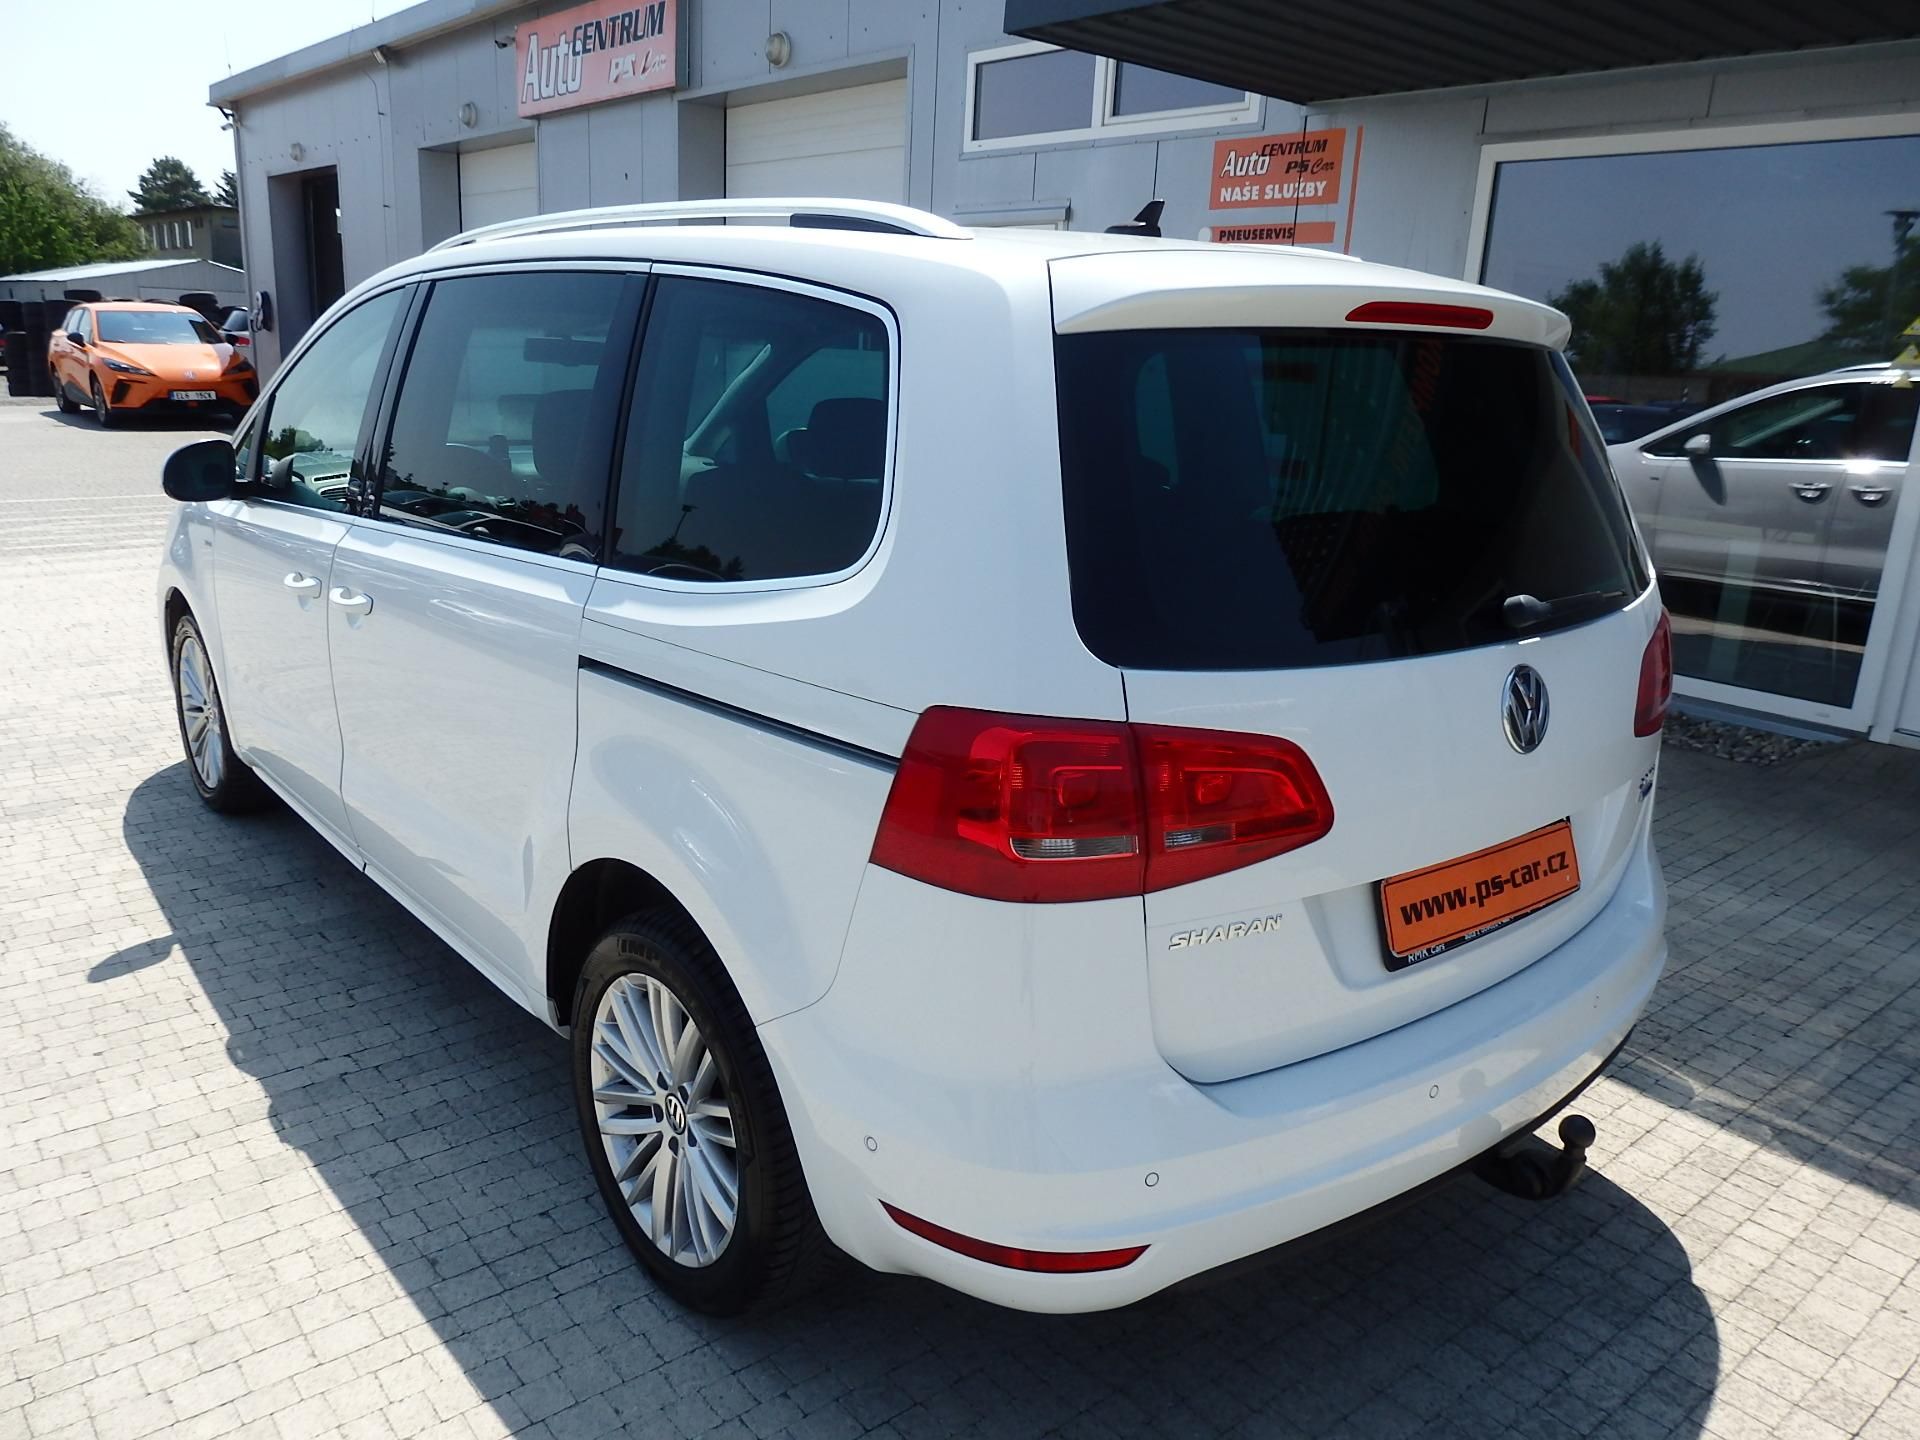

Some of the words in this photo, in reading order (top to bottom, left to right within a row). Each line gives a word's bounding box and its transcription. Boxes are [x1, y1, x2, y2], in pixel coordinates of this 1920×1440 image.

[521, 32, 583, 104] Auto
[571, 1, 666, 56] CENTRUM
[1220, 150, 1271, 178] Auto
[1260, 139, 1328, 156] CENTRUM
[1285, 159, 1310, 174] PS
[1310, 157, 1334, 174] Car
[1220, 182, 1259, 202] NAŠE
[1264, 177, 1327, 200] SLUŽBY
[1219, 227, 1294, 242] PNEUSERVIS
[1400, 851, 1569, 925] www.ps-car.cz
[1169, 913, 1282, 951] SHARAN
